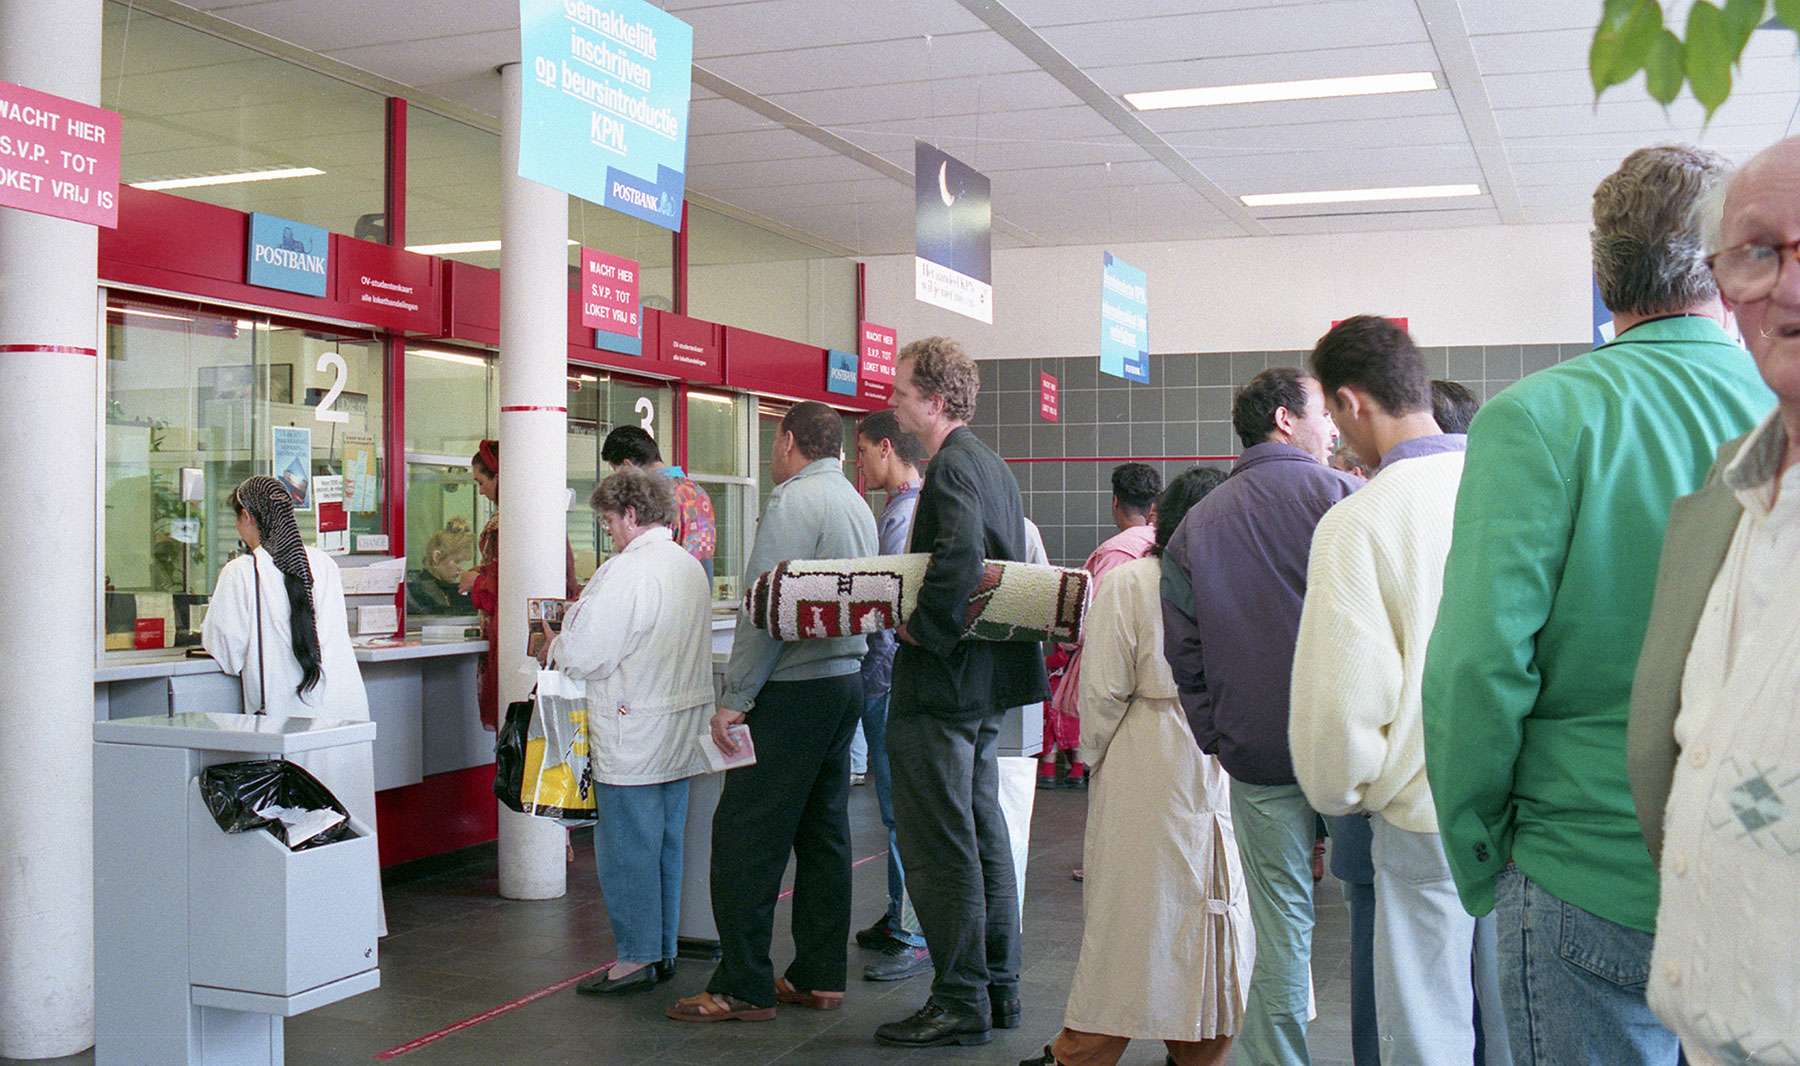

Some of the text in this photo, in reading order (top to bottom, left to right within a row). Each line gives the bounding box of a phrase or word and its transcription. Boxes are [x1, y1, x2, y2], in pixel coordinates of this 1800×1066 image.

[564, 0, 657, 57] Gemakkelijk
[571, 27, 651, 89] inschrijven
[535, 56, 679, 137] op beursintroductie
[67, 118, 106, 144] HIER
[0, 135, 97, 176] S.V.P. TOT
[0, 167, 113, 209] OKET VRIJ IS
[613, 182, 659, 211] POSTBANK
[255, 244, 326, 275] POSTBANK
[590, 261, 634, 283] WACHT HIER
[592, 283, 631, 304] S.V.P. TOT
[585, 303, 638, 325] LOKET VRIJ IS
[315, 352, 349, 423] 2
